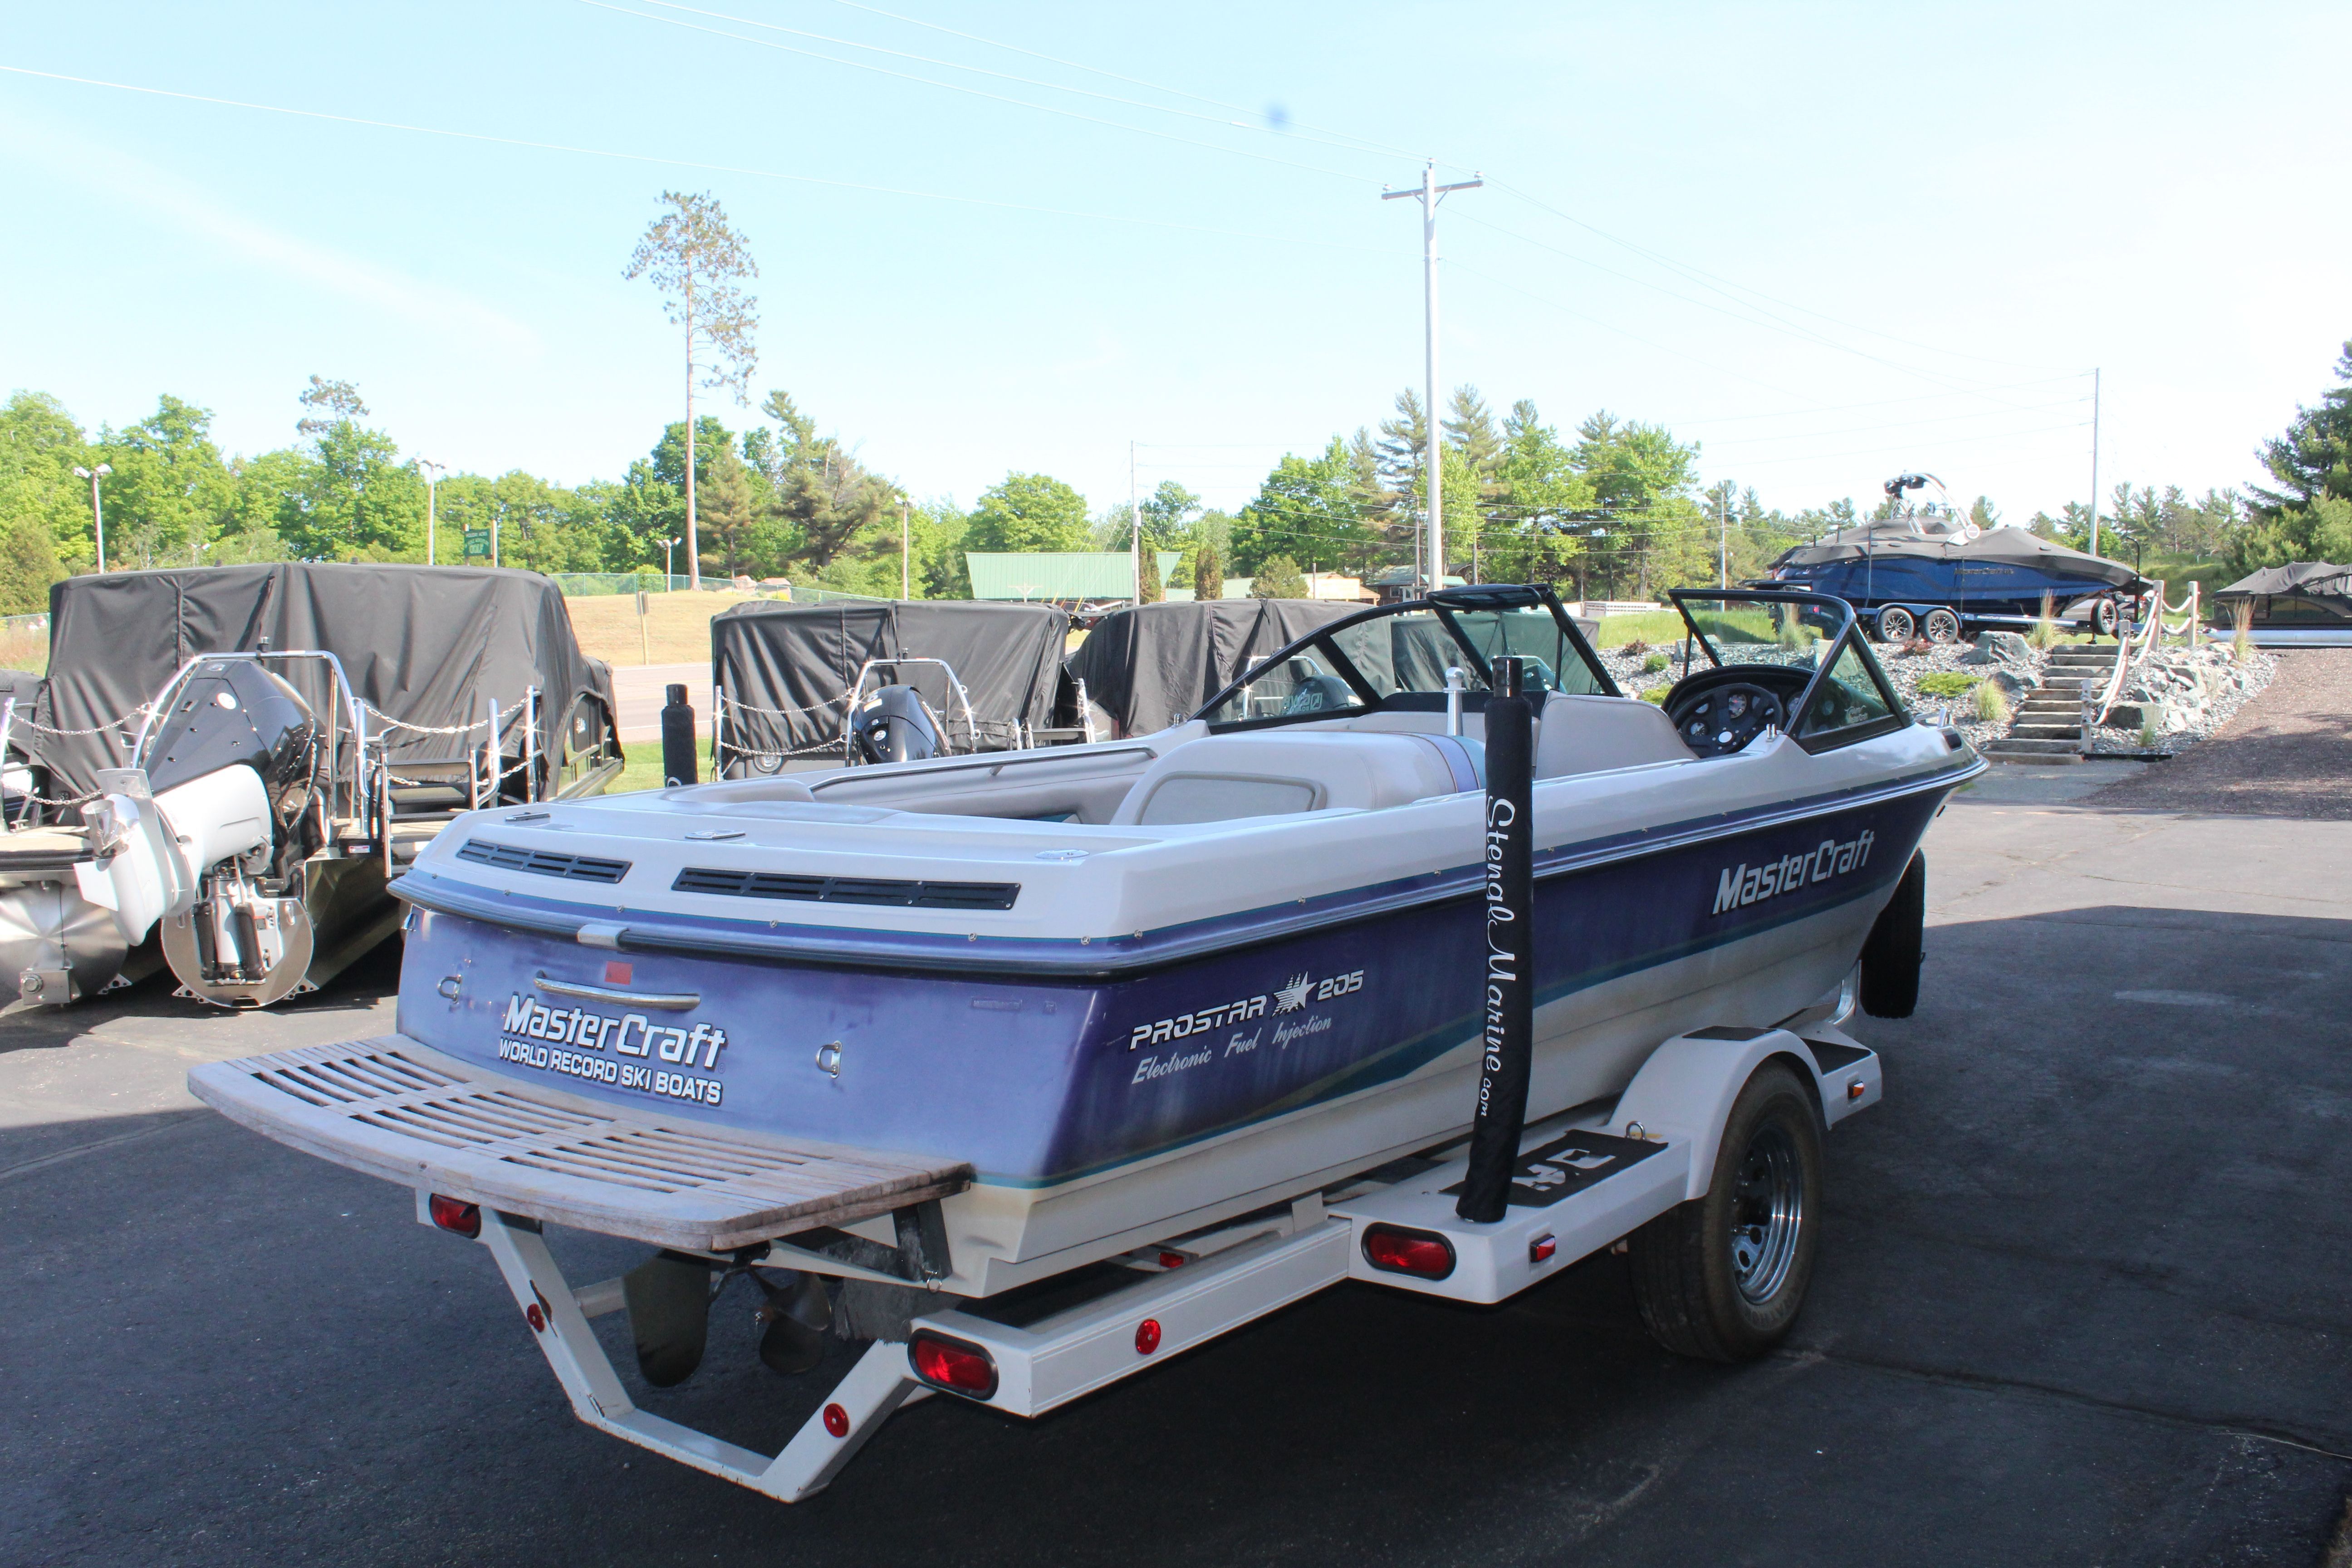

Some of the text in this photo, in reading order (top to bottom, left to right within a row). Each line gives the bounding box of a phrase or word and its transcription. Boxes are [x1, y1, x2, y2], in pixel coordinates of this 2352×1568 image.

[469, 543, 484, 554] GOLF
[1712, 829, 1875, 914] MasterCraft
[503, 994, 727, 1069] MasterCraft
[1130, 970, 1364, 1050] PROSTAR 205
[1486, 919, 1516, 1071] Marine
[499, 1037, 723, 1106] WORLD RECORD SKI BOATS
[1131, 1014, 1332, 1084] Electronic Fuel Injection
